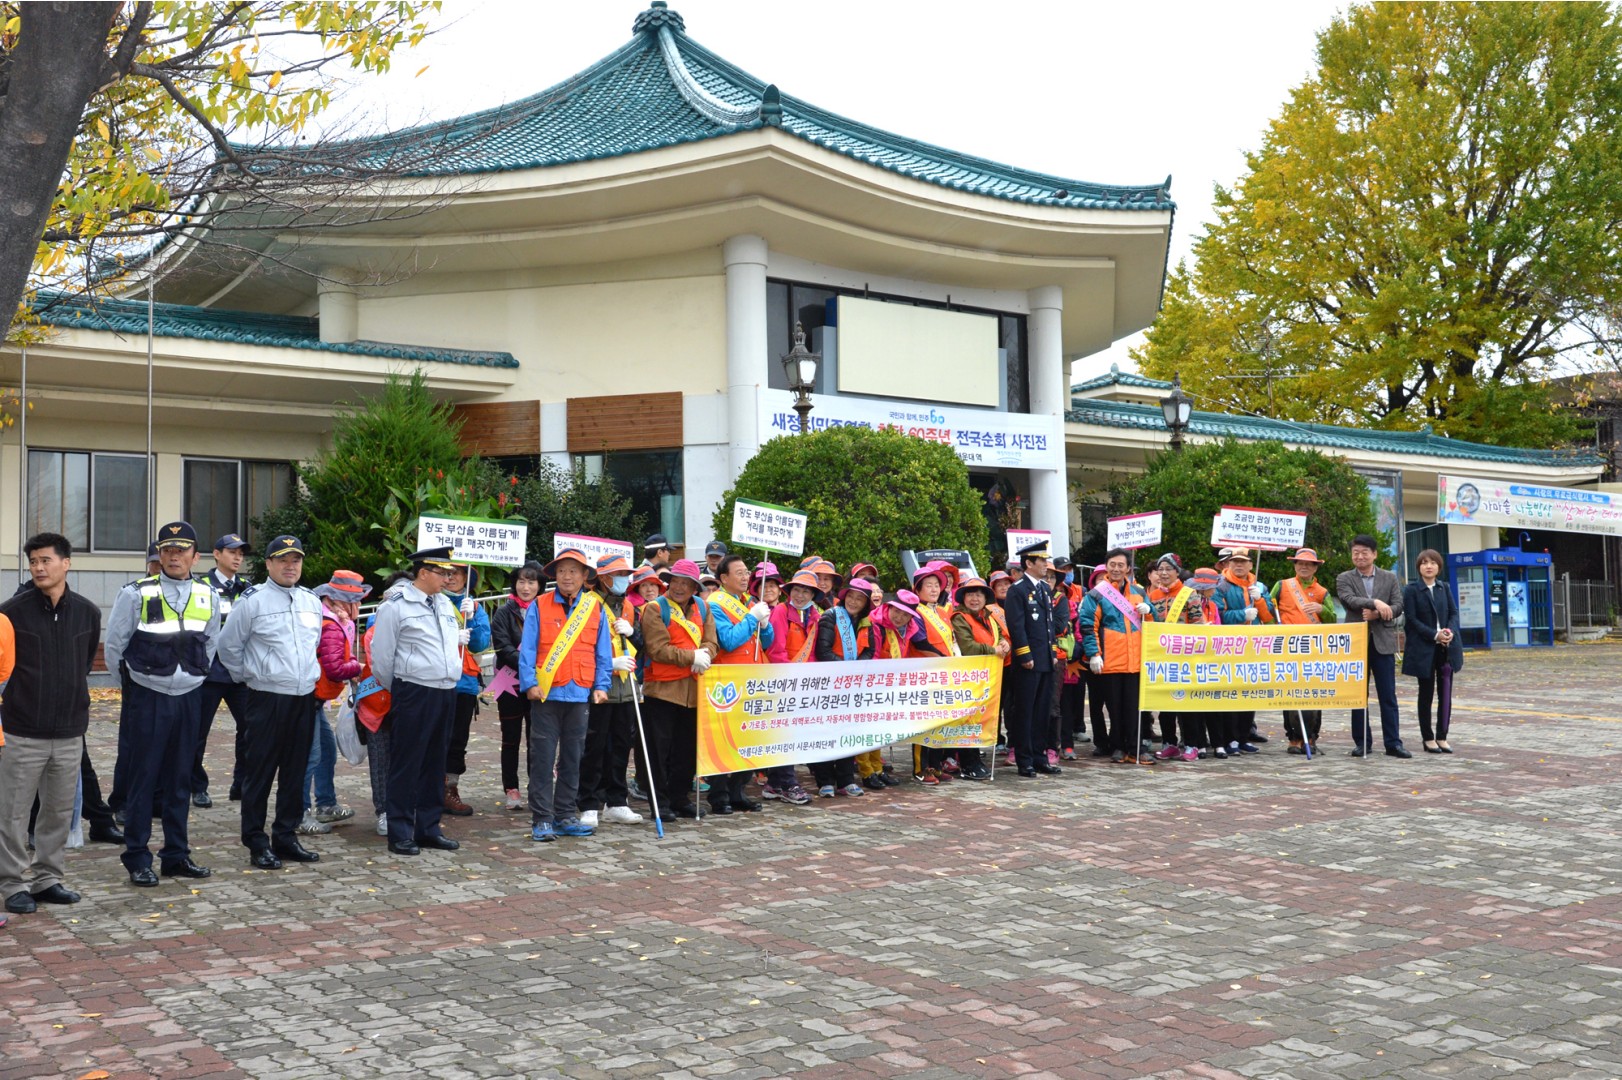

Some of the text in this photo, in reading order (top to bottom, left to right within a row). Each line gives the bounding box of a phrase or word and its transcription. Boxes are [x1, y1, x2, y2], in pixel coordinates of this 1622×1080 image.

[889, 411, 905, 420] 국민과
[909, 426, 951, 445] 60주년
[956, 430, 1007, 449] 전국순회
[1011, 431, 1048, 451] 사진전
[754, 510, 773, 523] 부산을
[1515, 500, 1553, 518] 나눔밥상
[746, 521, 765, 534] 거리를
[1234, 513, 1293, 526] 조금만 관심 가지면
[447, 524, 475, 536] 부산을
[478, 526, 520, 540] 아름답게!
[1221, 521, 1248, 532] 우리부산
[1250, 524, 1271, 534] 깨끗한
[1272, 526, 1286, 536] 부산
[435, 535, 508, 551] 거리를 깨끗하게!
[1159, 634, 1351, 655] 아름답고 깨끗한 거리를 만들기 위해
[1145, 660, 1364, 684] 게시물은 반드시 지정된 곳에 부착합시다!
[746, 678, 798, 695] 청소년에게
[800, 676, 831, 691] 위해한
[833, 674, 863, 690] 선정적
[951, 669, 989, 684] 일소하여
[743, 700, 773, 715] 머물고
[777, 697, 797, 713] 싶은
[799, 693, 850, 710] 도시경관의
[853, 691, 894, 708] 항구도시
[897, 689, 930, 706] 부산을
[1190, 689, 1336, 699] (사)아름다운 부산만들기 시민운동본부
[826, 713, 852, 724] 자동차에
